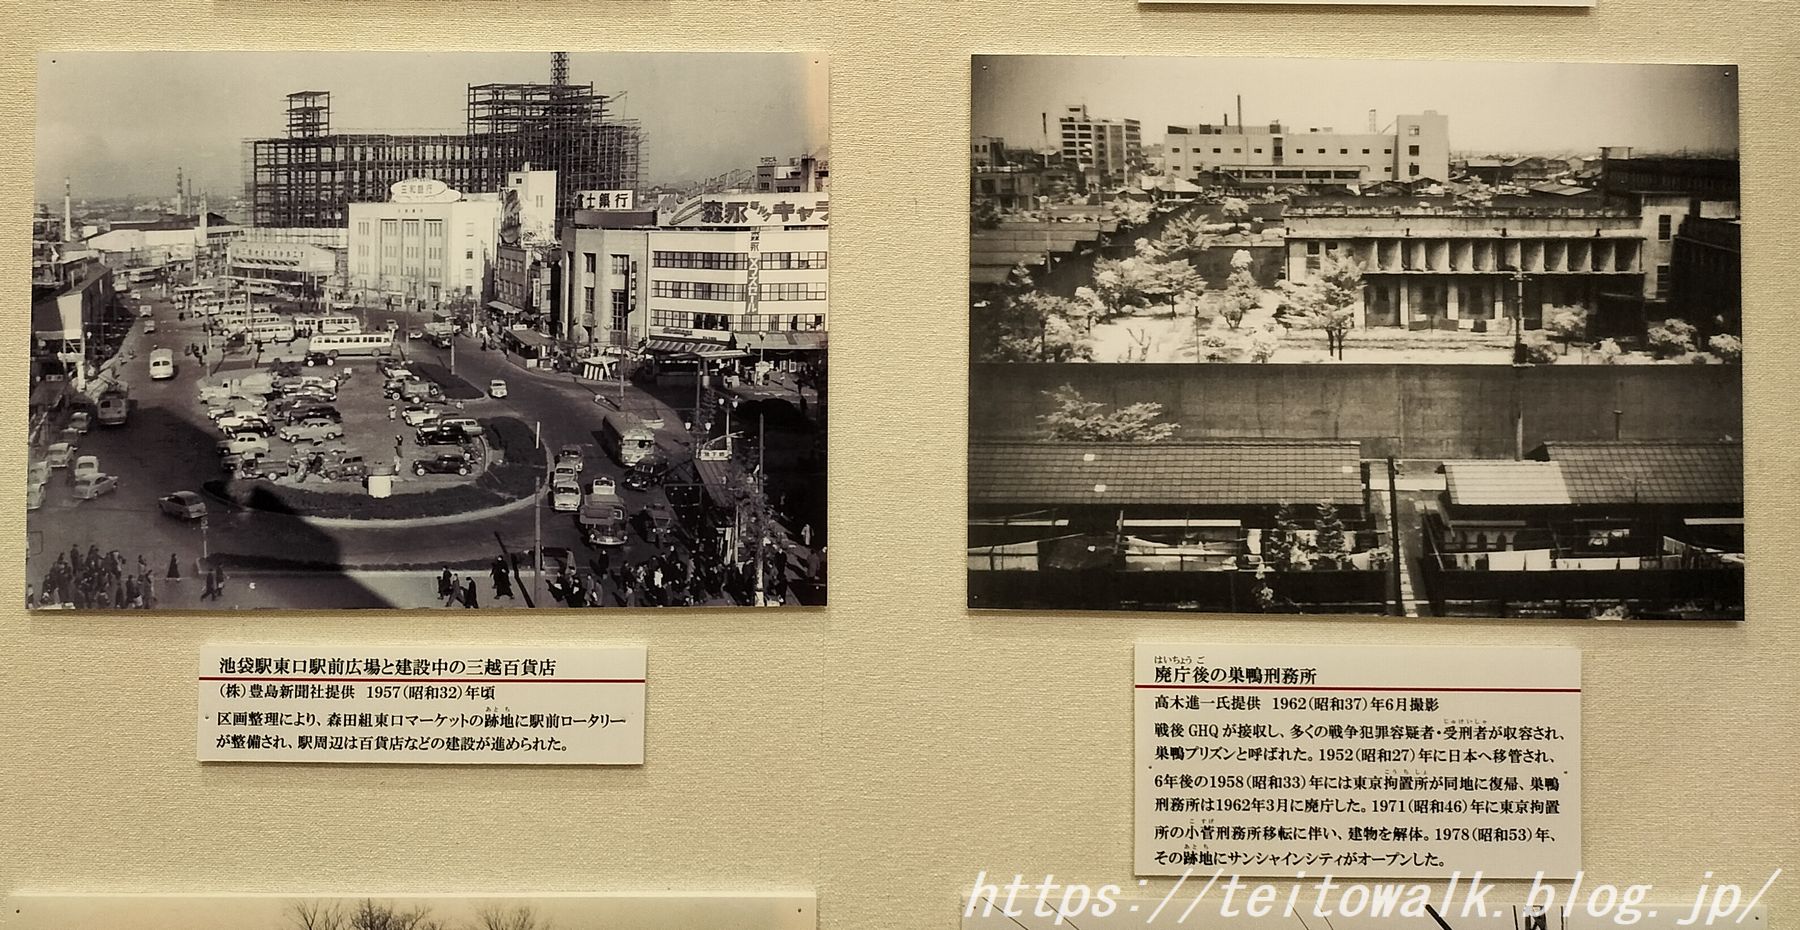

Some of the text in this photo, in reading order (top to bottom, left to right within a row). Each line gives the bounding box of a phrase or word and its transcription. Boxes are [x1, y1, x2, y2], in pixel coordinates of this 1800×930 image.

[218, 657, 557, 677] 池袋駅東口駅前広場と建設中の三越百貨店
[1153, 665, 1318, 687] 廃庁後の巣鴨刑務所
[1272, 696, 1440, 713] 1962（昭和37）年6月撮影
[217, 710, 627, 729] 区画整理により、森田組東口マーケットの跡地に駅前ロータリー
[215, 733, 568, 752] が整備され、駅周辺は百貨店などの建設が進められた。
[1154, 746, 1556, 764] 巣鴨プリズンと呼ばれた。1952（昭和27）年に日本へ移管され、
[1154, 773, 1560, 792] 6年後の1958（昭和33）年には東京拘置所が同地に復帰、巣鴨
[1154, 796, 1560, 815] 刑務所は1962年3月に廃庁した。1971（昭和46）年に東京拘置
[1154, 823, 1557, 845] 所の小菅刑務所移転に伴い、建物を解体。1978（昭和53）年、
[1154, 849, 1446, 868] その跡地にサンシャインシティがオープンした。
